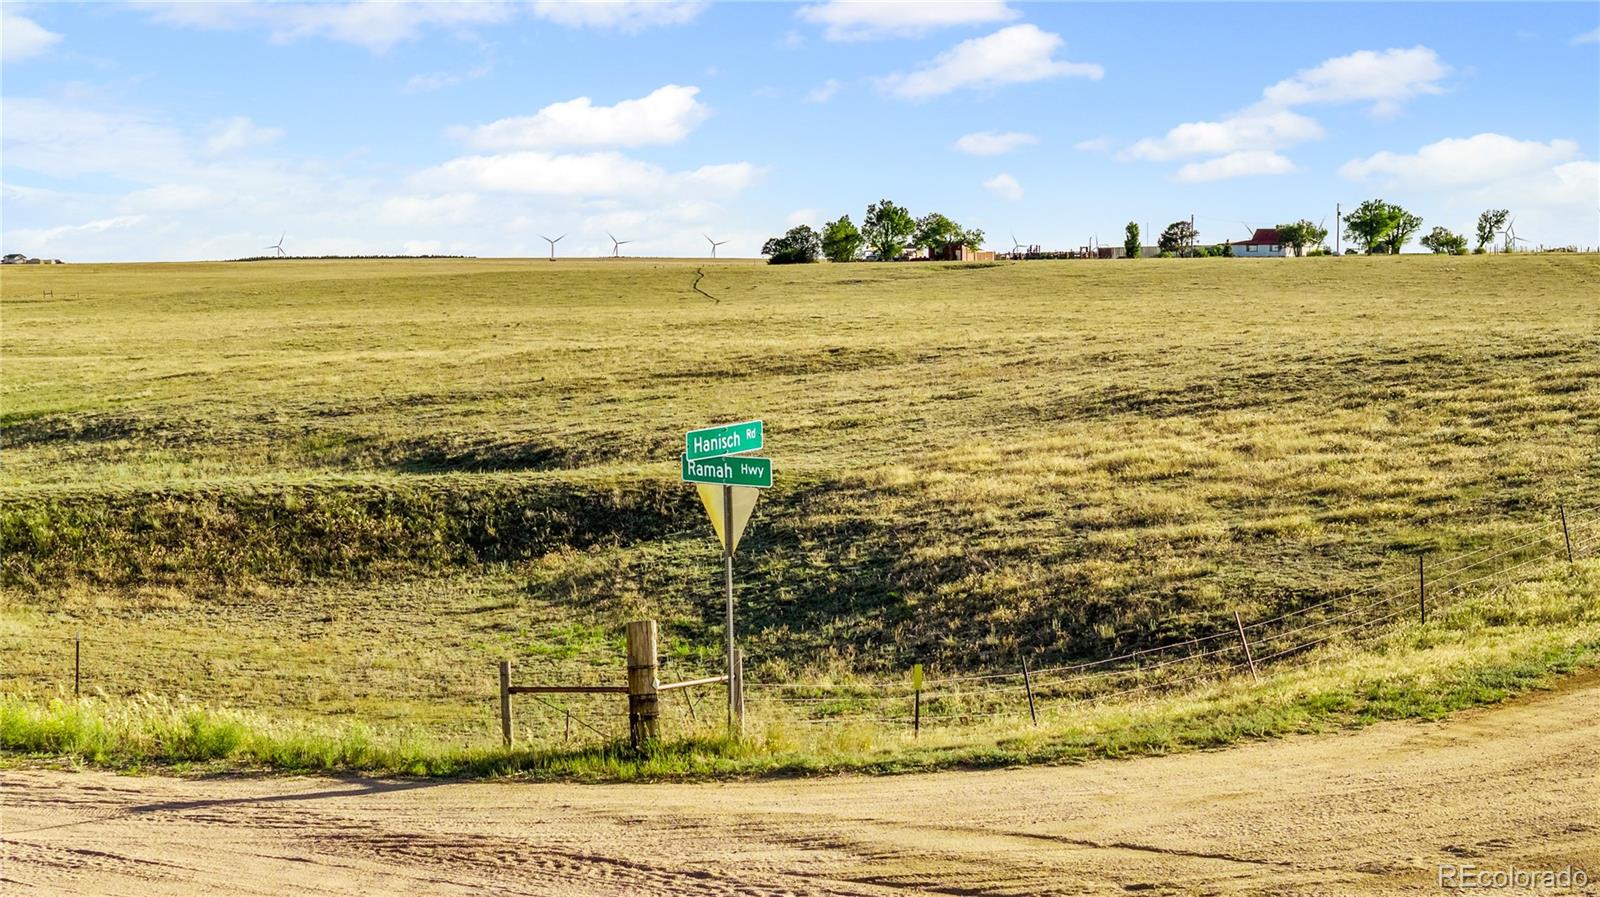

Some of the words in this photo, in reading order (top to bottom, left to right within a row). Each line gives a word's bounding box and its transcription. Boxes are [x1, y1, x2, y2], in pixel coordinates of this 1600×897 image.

[694, 431, 740, 453] Hanisch
[746, 428, 756, 440] Rd
[688, 461, 732, 478] Ramah
[741, 464, 764, 478] Hwy
